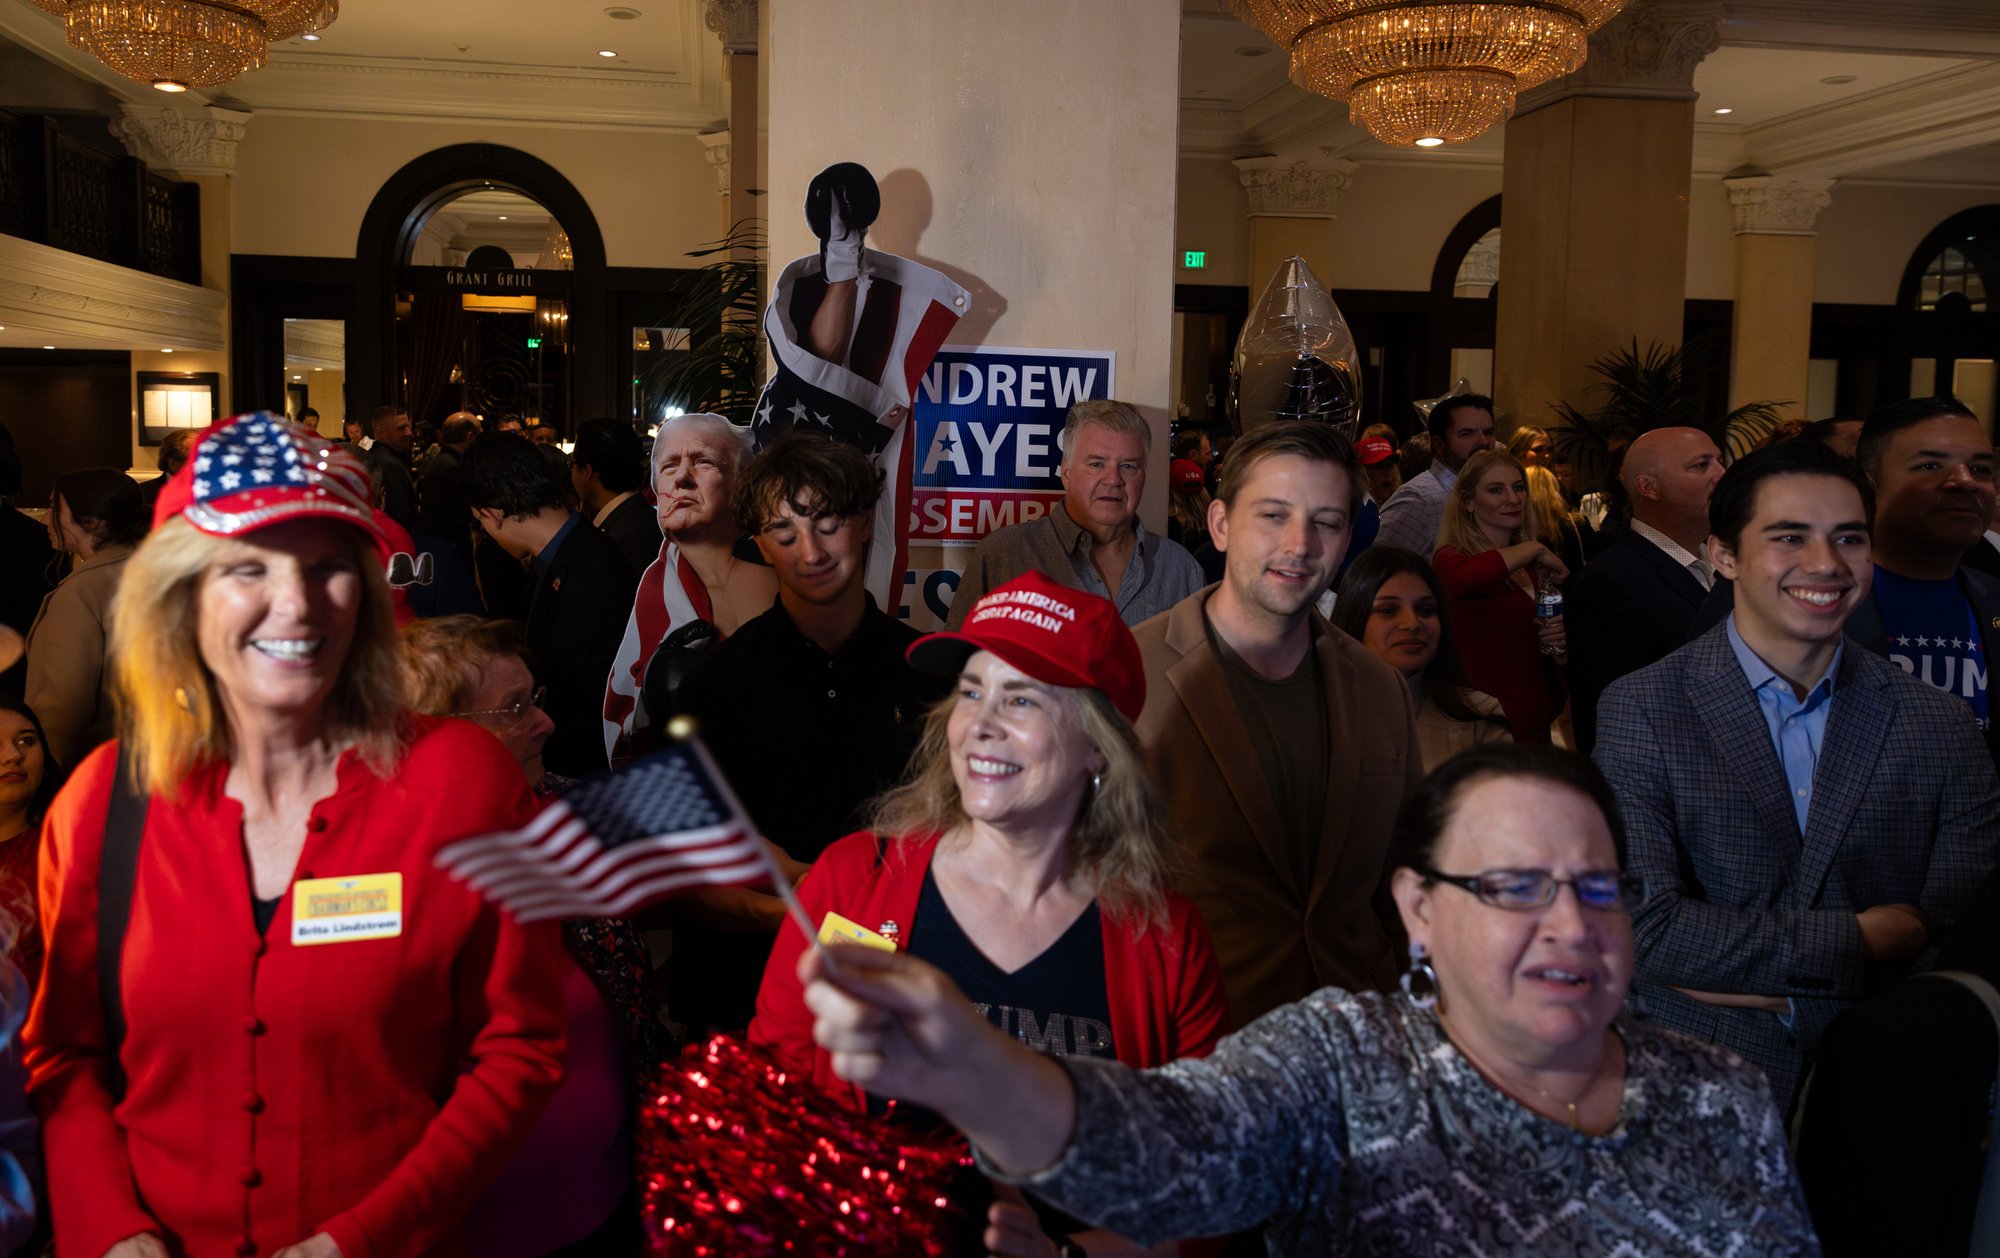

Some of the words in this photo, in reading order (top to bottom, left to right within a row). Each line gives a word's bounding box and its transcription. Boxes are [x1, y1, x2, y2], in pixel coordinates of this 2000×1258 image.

[1185, 251, 1205, 268] EXIT
[447, 271, 487, 286] GRANT
[497, 272, 533, 287] GRILL
[914, 420, 1065, 478] AYE
[1185, 471, 1200, 479] USA
[909, 498, 1061, 534] SEMB
[1009, 590, 1075, 621] AMERICA
[1009, 607, 1063, 634] AGAIN
